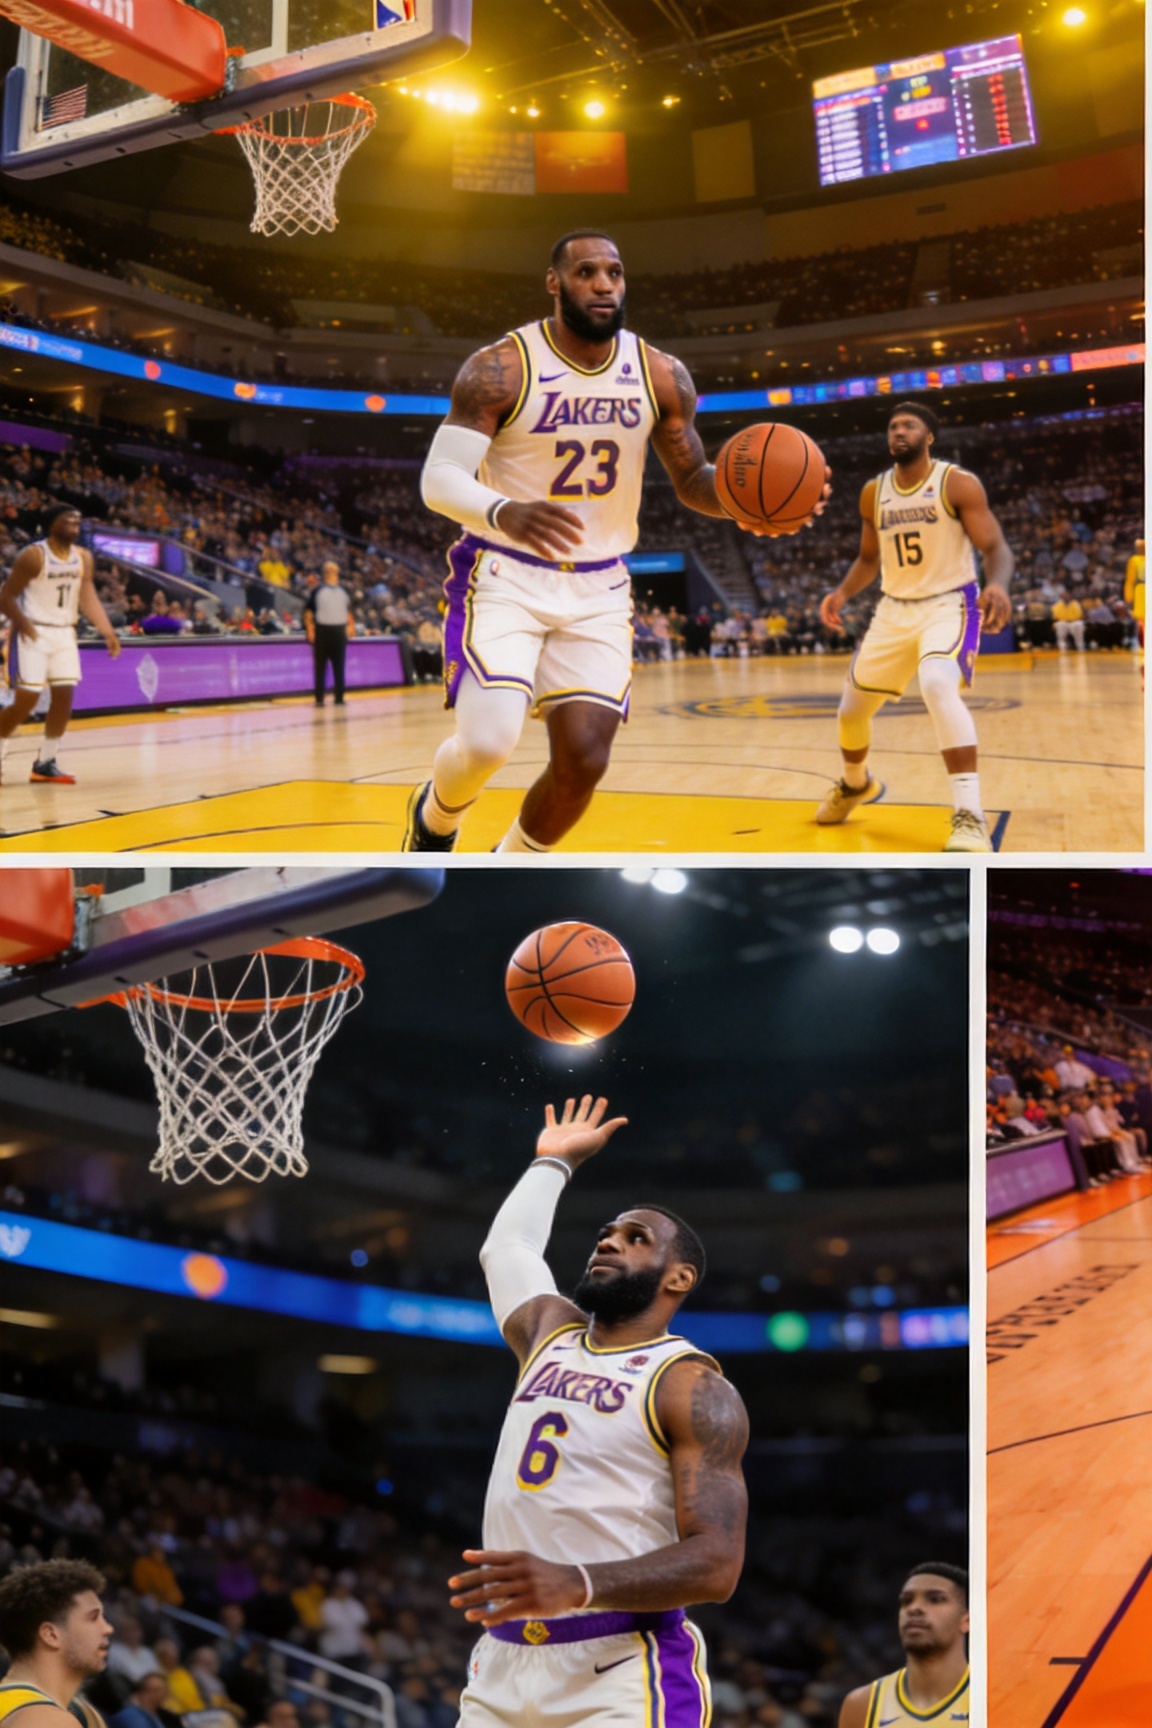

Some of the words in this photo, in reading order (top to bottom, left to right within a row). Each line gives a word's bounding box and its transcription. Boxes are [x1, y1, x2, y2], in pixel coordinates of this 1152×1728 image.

[528, 391, 642, 434] LAKERS
[549, 439, 621, 497] 23
[894, 531, 923, 567] 15
[514, 1361, 634, 1415] LAKERS
[516, 1410, 568, 1492] 6
